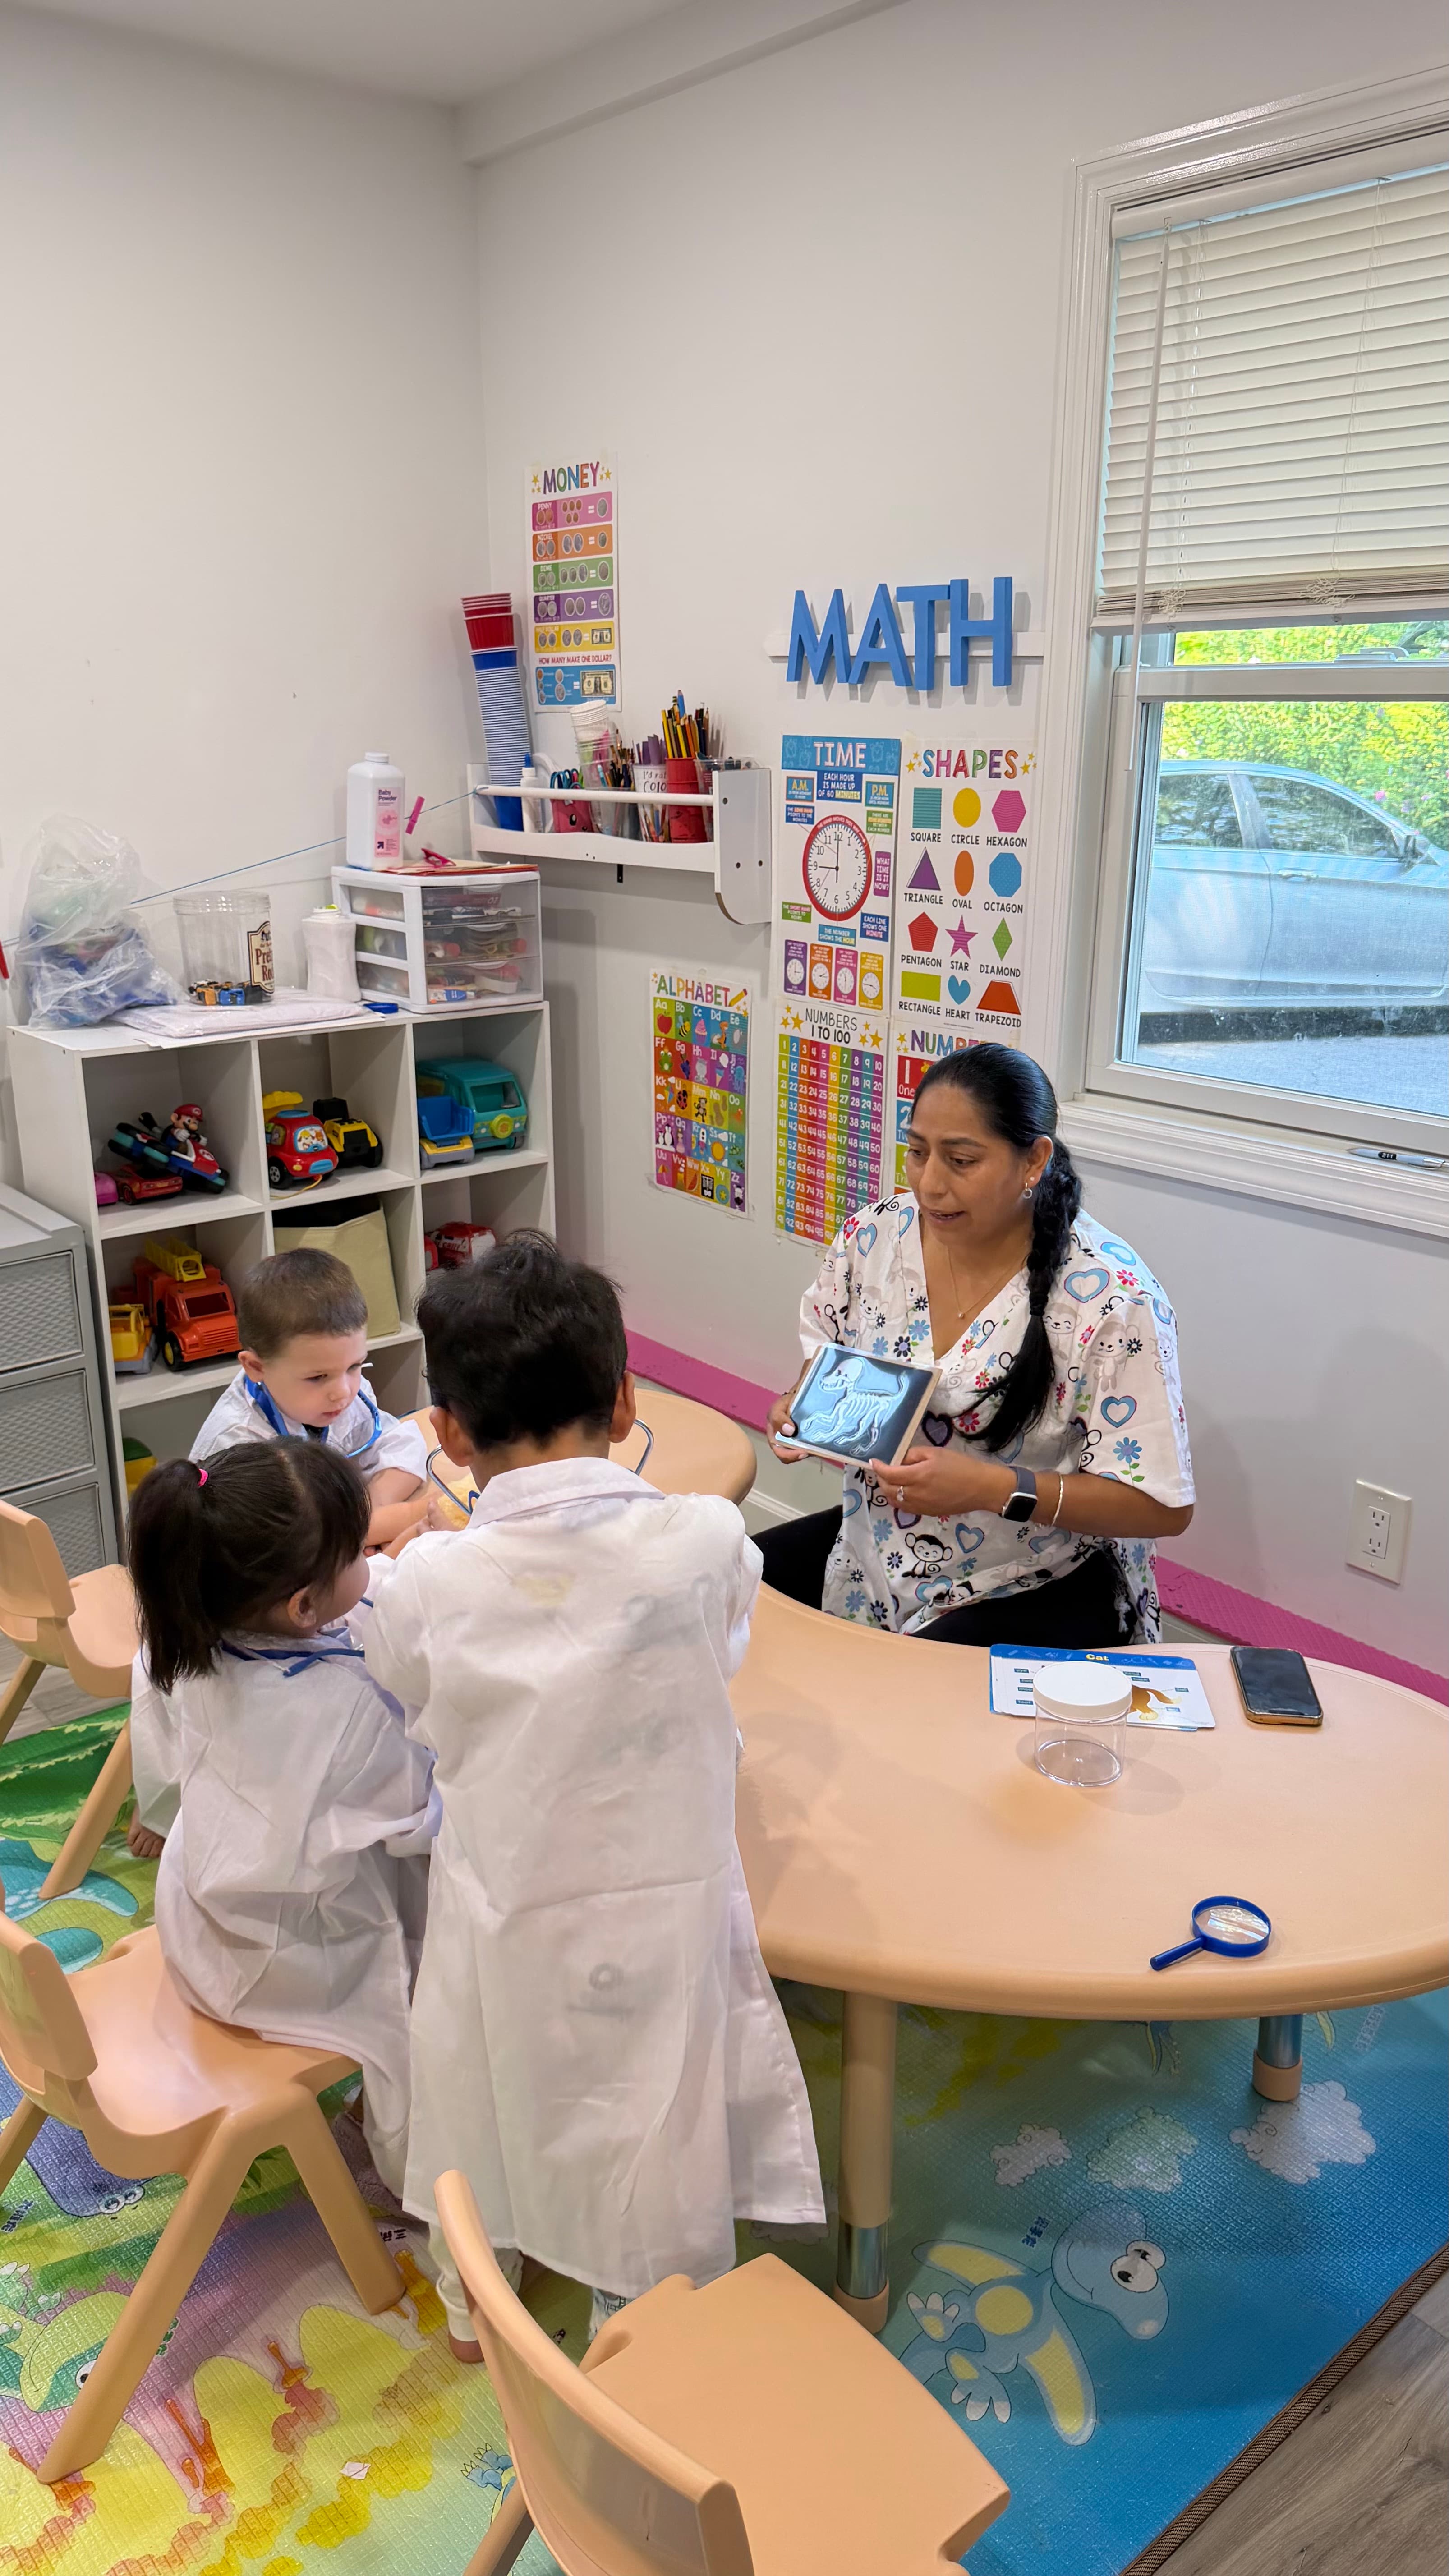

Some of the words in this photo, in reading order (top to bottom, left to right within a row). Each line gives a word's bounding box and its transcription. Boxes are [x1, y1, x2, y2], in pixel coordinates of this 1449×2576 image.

[543, 461, 599, 494] MONEY
[787, 577, 1012, 690] MATH
[814, 741, 866, 768] TIME
[922, 750, 1018, 779] SHAPES
[644, 781, 667, 793] Colo
[792, 780, 808, 791] A.M.
[872, 785, 888, 796] P.M.
[824, 835, 831, 844] 11
[834, 832, 843, 841] 12
[848, 837, 851, 846] 1
[911, 832, 941, 842] SQUARE
[951, 834, 980, 845] CIRCLE
[986, 836, 1027, 847] HEXAGON
[817, 846, 824, 855] 10
[855, 849, 859, 859] 2
[814, 861, 818, 870] 9
[857, 866, 861, 875] 3
[816, 878, 820, 887] 8
[824, 888, 828, 897] 7
[853, 883, 857, 891] 4
[834, 895, 838, 904] 6
[846, 891, 850, 900] 5
[904, 892, 943, 905] TRIANGLE
[952, 899, 972, 909] OVAL
[984, 902, 1023, 914] OCTAGON
[901, 955, 942, 967] PENTAGON
[951, 961, 969, 971] STAR
[980, 964, 1021, 978] DIAMOND
[657, 975, 730, 1007] ALPHABET
[655, 999, 667, 1009] Aa
[676, 1002, 685, 1012] Bb
[693, 1006, 702, 1017] Cc
[711, 1010, 721, 1021] Dd
[730, 1014, 740, 1024] Ee
[805, 1008, 857, 1031] NUMBERS
[899, 1001, 941, 1015] RECTANGLE
[945, 1008, 970, 1020] HEART
[975, 1012, 1021, 1027] TRAPEZOID
[812, 1025, 814, 1037] 1
[818, 1026, 830, 1040] TO
[834, 1029, 851, 1044] 100
[911, 1030, 989, 1057] NUMB
[655, 1038, 666, 1047] Ff
[676, 1041, 685, 1054] Gg
[693, 1045, 702, 1056] Hh
[783, 1040, 786, 1049] 1
[792, 1043, 796, 1052] 2
[803, 1045, 807, 1054] 3
[812, 1047, 816, 1056] 4
[822, 1050, 826, 1058] 5
[832, 1052, 837, 1061] 6
[843, 1054, 847, 1063] 7
[854, 1056, 859, 1066] 8
[865, 1058, 869, 1068] 9
[875, 1061, 882, 1071] 10
[791, 1062, 797, 1072] 12
[801, 1065, 807, 1074] 13
[810, 1067, 817, 1076] 14
[820, 1069, 826, 1079] 15
[830, 1072, 837, 1081] 16
[841, 1074, 848, 1083] 17
[852, 1077, 859, 1086] 18
[864, 1079, 870, 1089] 19
[873, 1081, 882, 1091] 20
[906, 1059, 910, 1084] 1
[656, 1076, 666, 1086] Kk
[710, 1090, 720, 1100] Nn
[729, 1095, 740, 1105] Oo
[781, 1080, 787, 1089] 21
[790, 1082, 797, 1091] 22
[799, 1084, 807, 1094] 23
[809, 1087, 817, 1097] 24
[819, 1089, 827, 1099] 25
[829, 1092, 837, 1101] 26
[840, 1095, 848, 1104] 27
[851, 1097, 860, 1107] 28
[861, 1099, 871, 1110] 29
[873, 1102, 881, 1112] 30
[898, 1085, 915, 1097] One
[780, 1099, 787, 1108] 31
[789, 1102, 797, 1111] 32
[799, 1104, 807, 1113] 33
[808, 1107, 816, 1117] 34
[818, 1109, 826, 1119] 35
[828, 1112, 837, 1122] 36
[839, 1114, 847, 1124] 37
[849, 1117, 859, 1127] 38
[860, 1120, 870, 1130] 39
[871, 1122, 881, 1132] 40
[900, 1105, 911, 1128] 2
[656, 1112, 667, 1124] Pp
[676, 1117, 685, 1130] Qq
[710, 1127, 718, 1137] Ss
[729, 1132, 736, 1142] Tt
[657, 1150, 667, 1160] Uu
[701, 1163, 710, 1173] Xx
[716, 1167, 725, 1180] Yy
[731, 1172, 740, 1183] Zz
